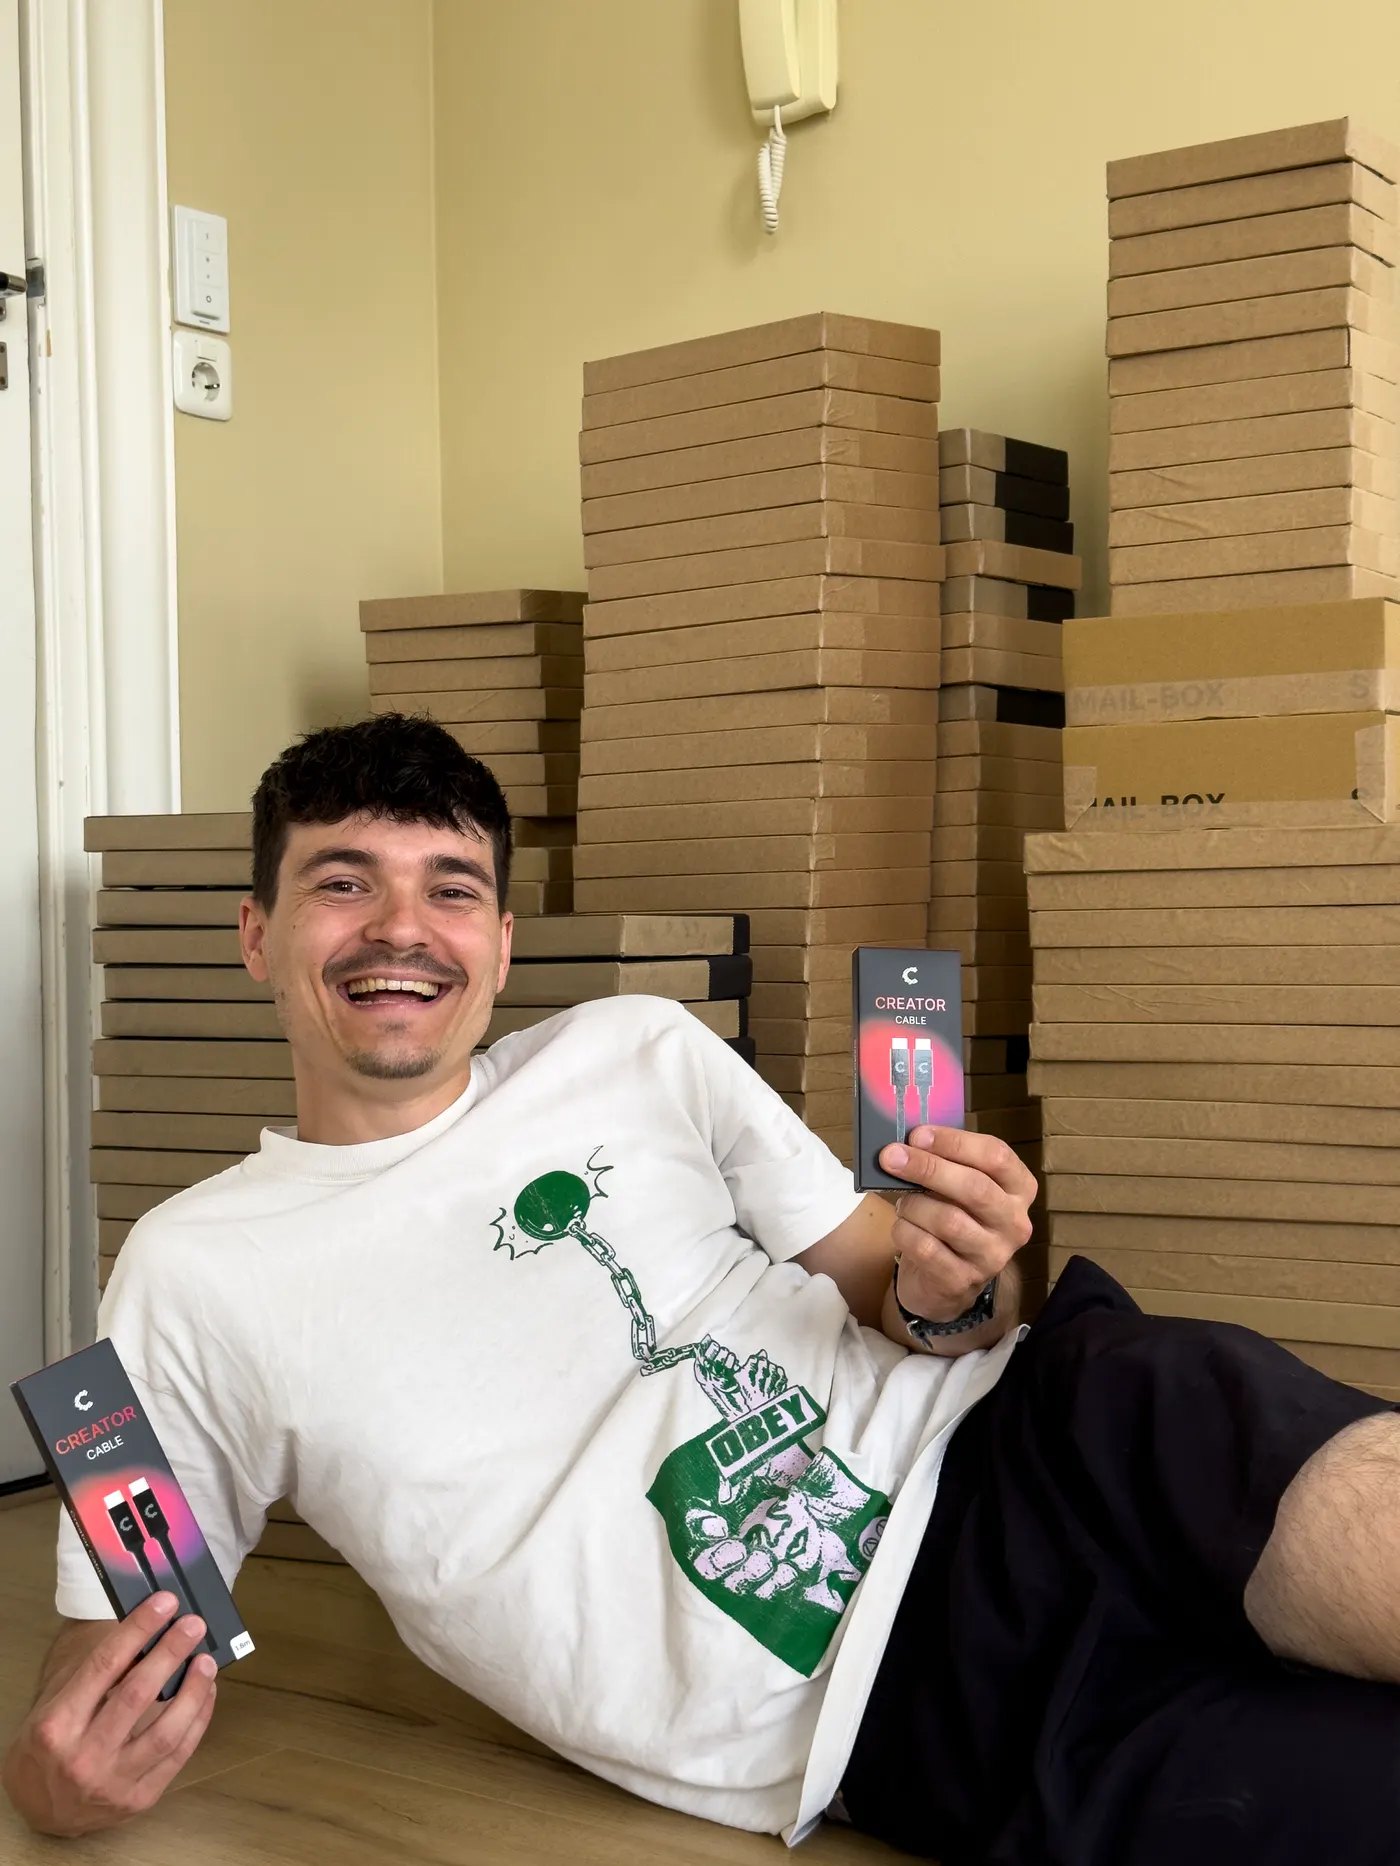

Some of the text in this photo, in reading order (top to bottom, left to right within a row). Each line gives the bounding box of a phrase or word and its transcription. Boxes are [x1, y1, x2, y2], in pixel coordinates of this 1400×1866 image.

[875, 996, 947, 1012] CREATOR
[895, 1015, 928, 1025] CABLE
[55, 1405, 137, 1455] CREATOR
[710, 1393, 807, 1468] OBEY
[86, 1435, 125, 1460] CABLE
